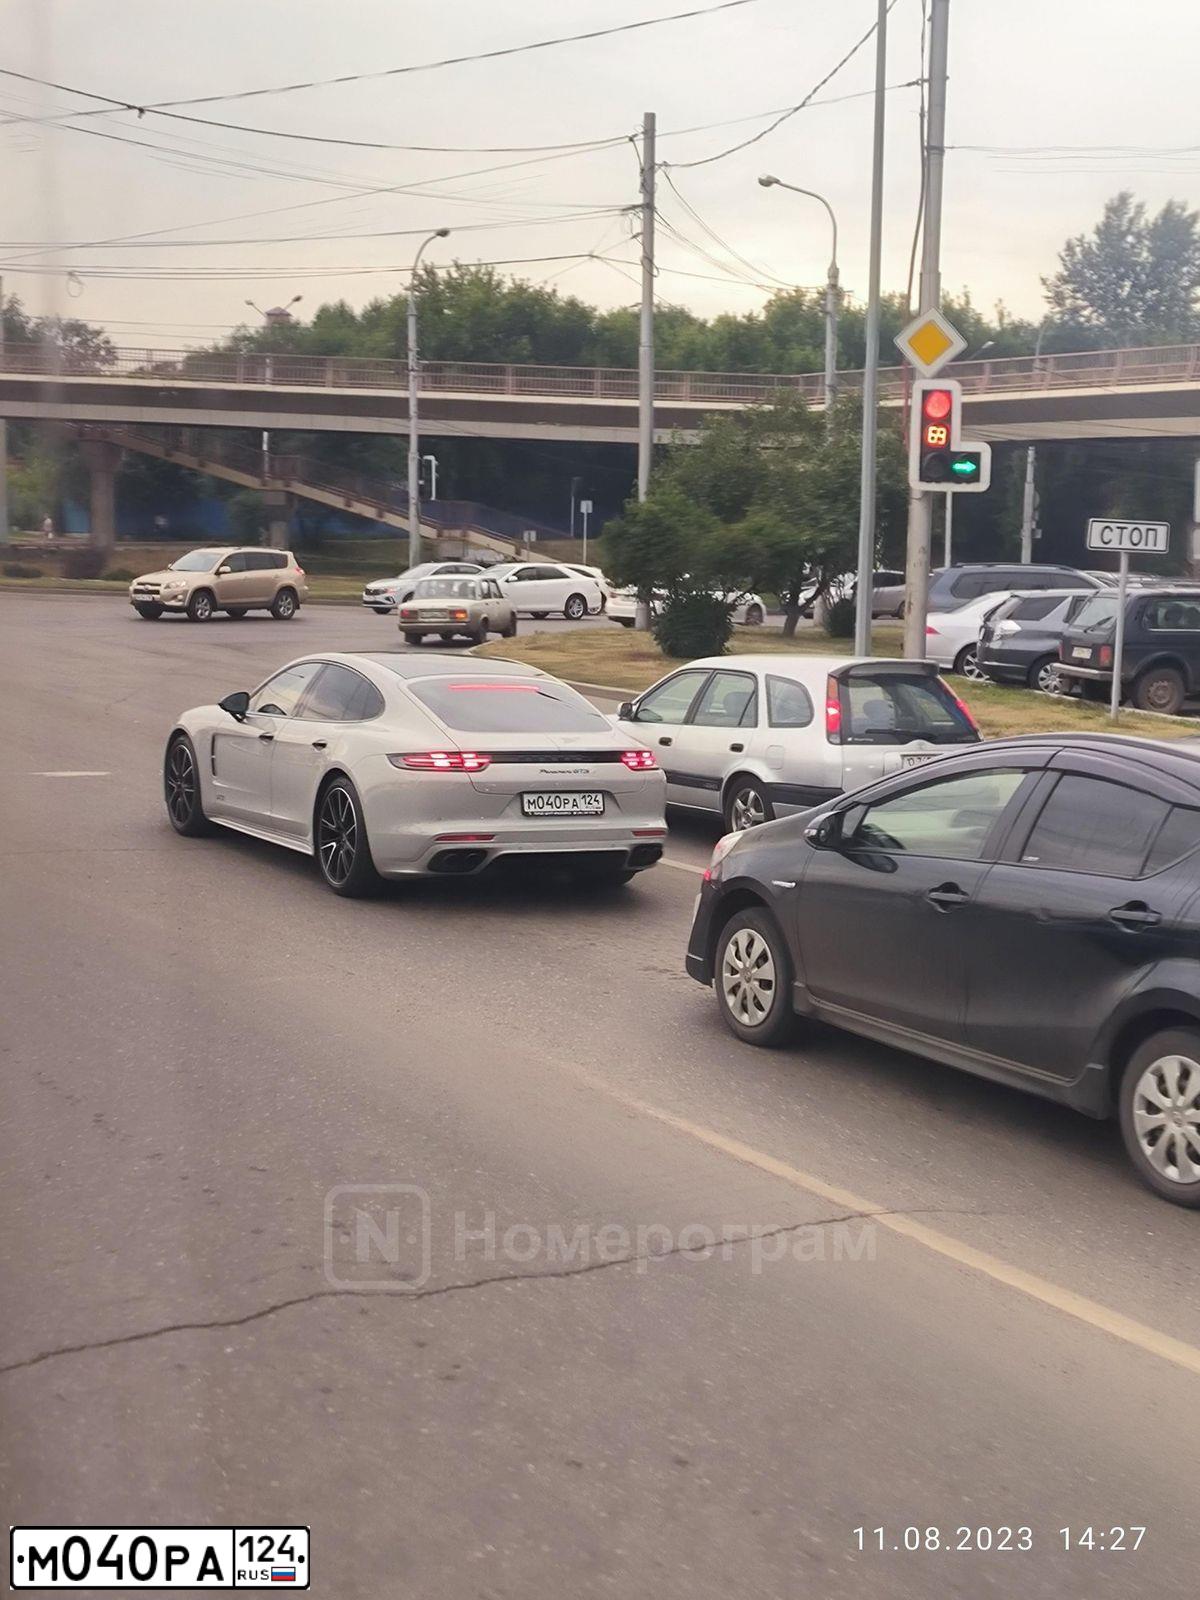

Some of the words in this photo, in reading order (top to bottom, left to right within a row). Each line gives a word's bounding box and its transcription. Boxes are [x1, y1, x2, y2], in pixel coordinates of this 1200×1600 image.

[1100, 525, 1158, 547] СТОП
[527, 795, 579, 810] М040РА
[581, 794, 600, 805] 124
